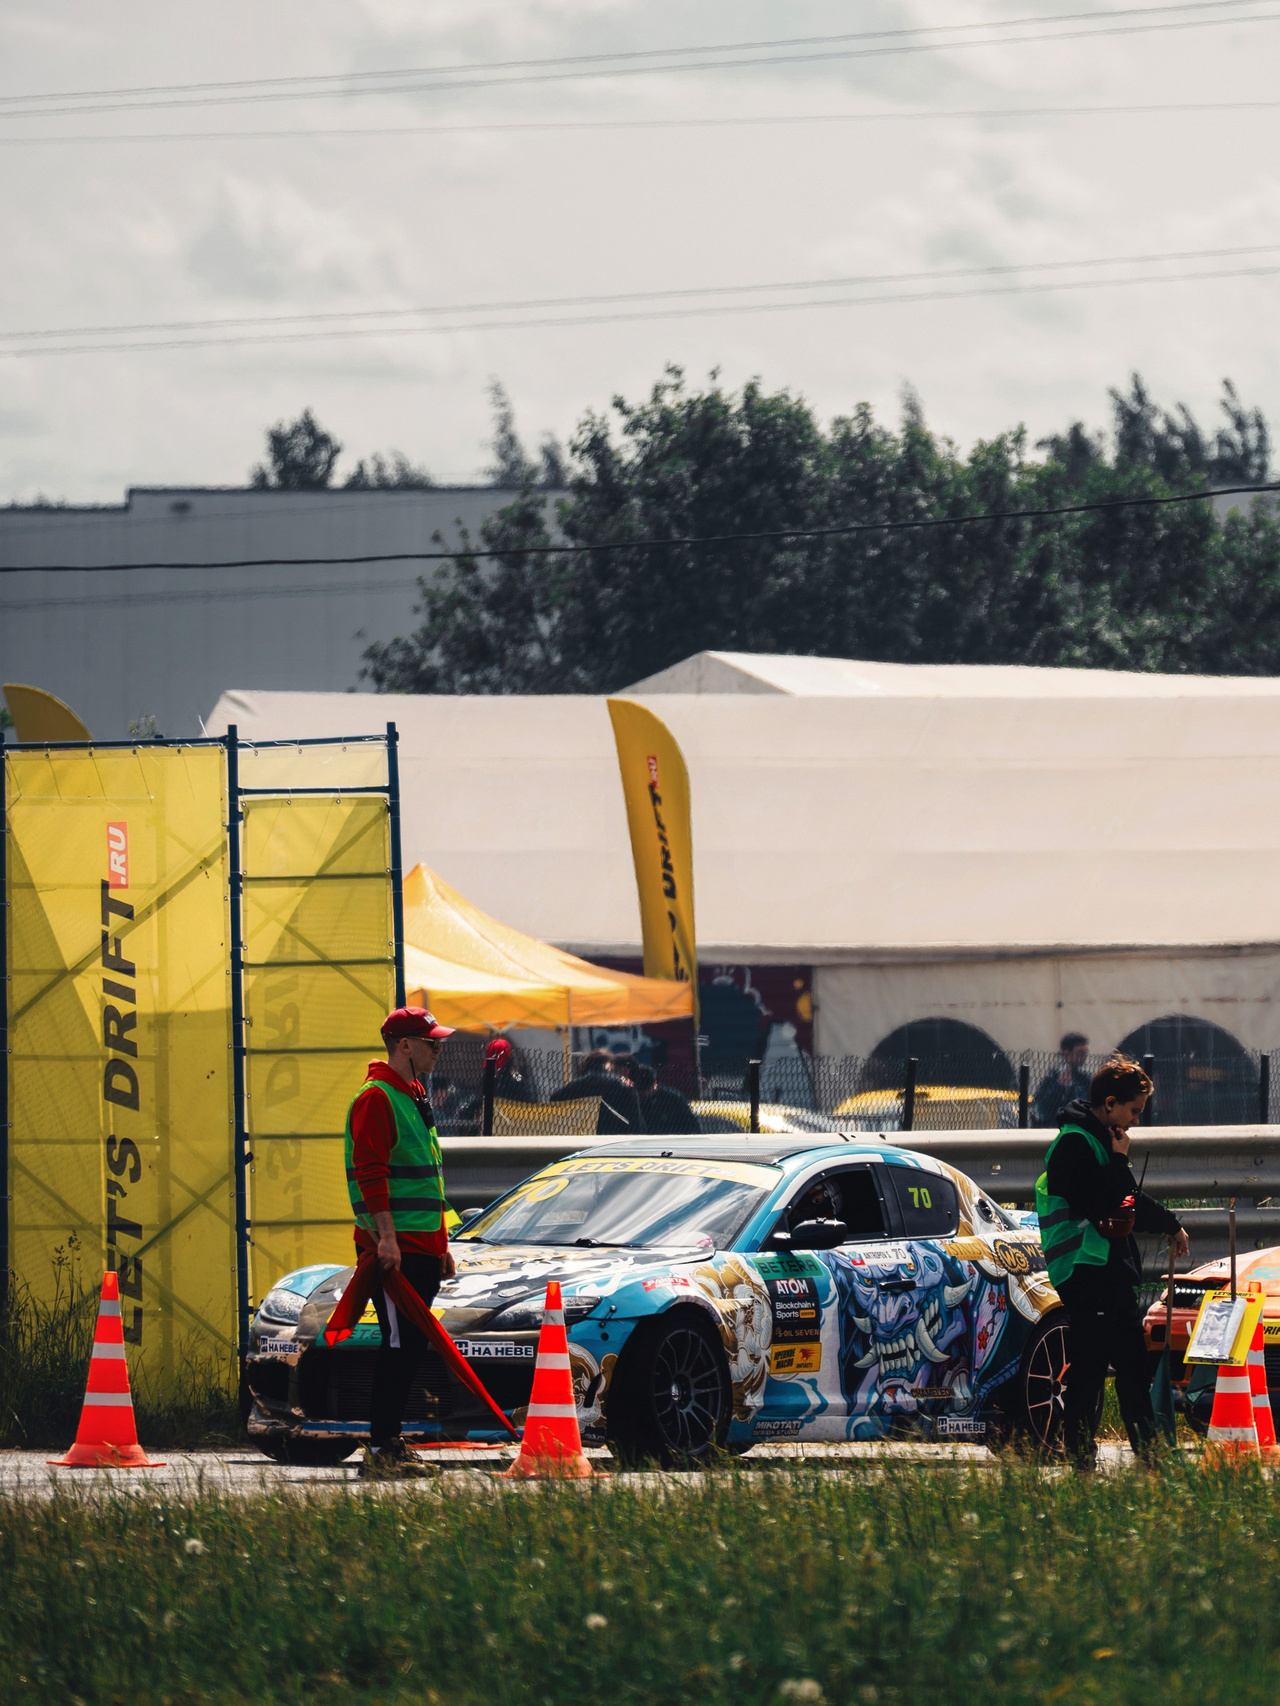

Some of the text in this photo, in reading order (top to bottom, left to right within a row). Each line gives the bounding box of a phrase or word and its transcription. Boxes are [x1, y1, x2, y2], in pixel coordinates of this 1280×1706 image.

[560, 1161, 634, 1174] LET'S
[637, 1161, 720, 1175] DRIFT
[908, 1187, 932, 1209] 70
[891, 1248, 907, 1260] 70
[776, 1279, 809, 1294] ATOM
[775, 1301, 812, 1309] Blockchain
[776, 1311, 799, 1319] Sports
[794, 1328, 819, 1336] SEVEN
[280, 1344, 298, 1354] НЕВЕ
[472, 1347, 533, 1357] НА НЕВЕ
[911, 1388, 956, 1397] CHAMELEON
[962, 1423, 986, 1432] НЕВЕ
